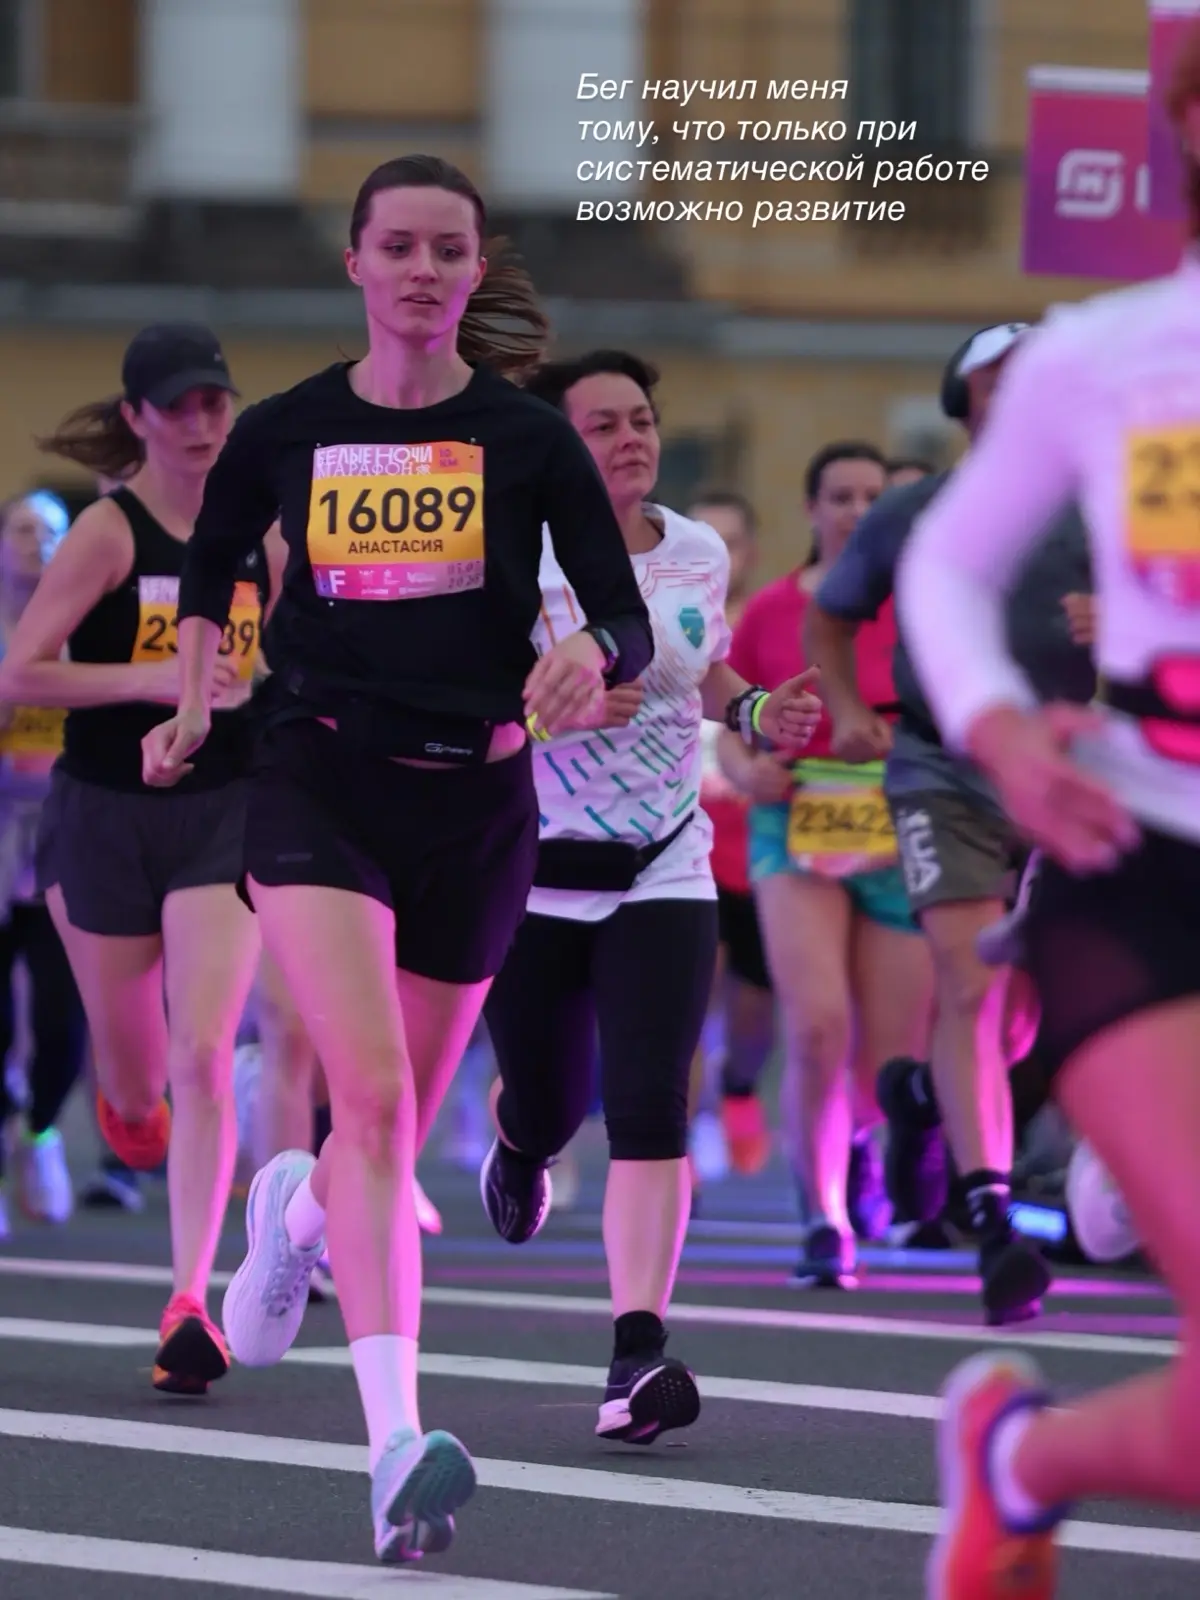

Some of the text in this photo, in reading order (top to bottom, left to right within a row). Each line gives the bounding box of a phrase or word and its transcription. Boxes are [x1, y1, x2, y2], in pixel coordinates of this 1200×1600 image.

[372, 446, 433, 463] НОЧИ
[319, 486, 476, 535] 16089
[347, 539, 444, 555] АНАСТАСИЯ
[328, 570, 347, 594] F
